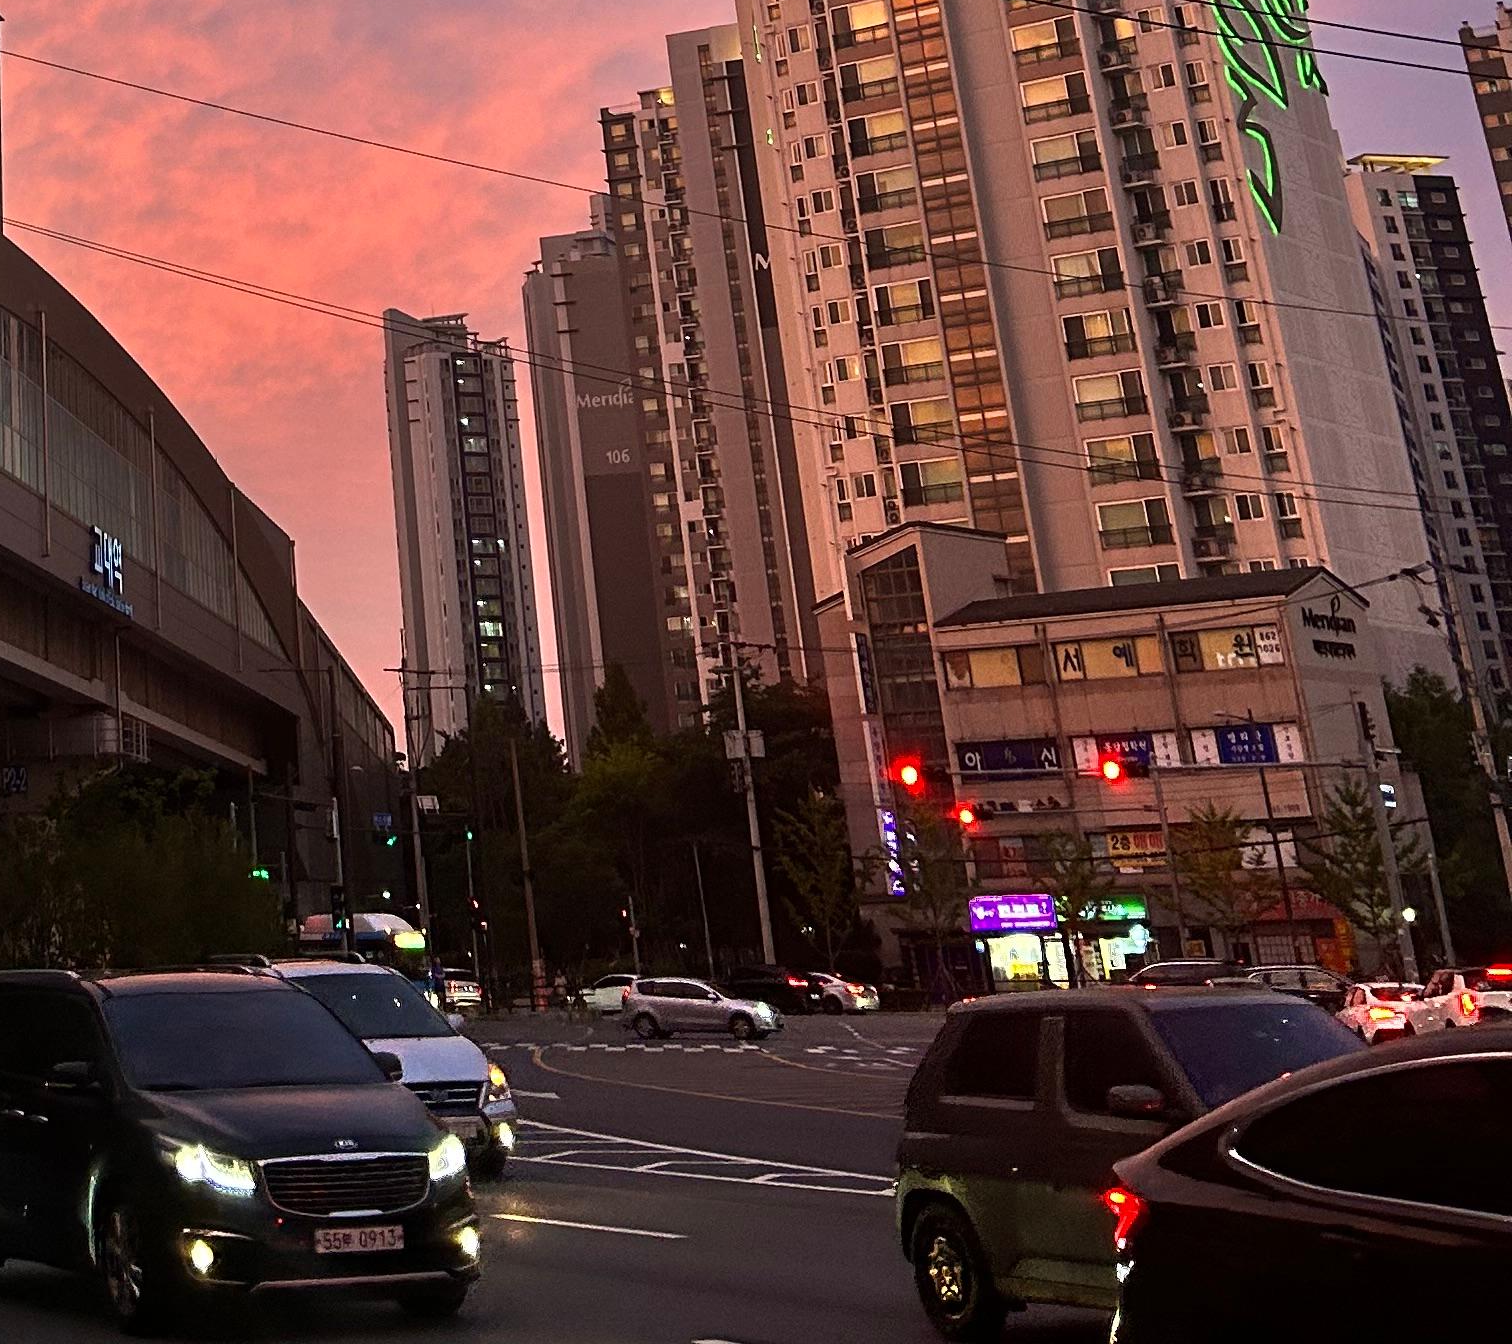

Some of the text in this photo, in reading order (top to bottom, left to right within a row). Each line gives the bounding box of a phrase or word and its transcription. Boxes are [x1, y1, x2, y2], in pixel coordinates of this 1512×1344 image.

[606, 448, 630, 464] 106
[94, 524, 124, 596] 교대역
[359, 1227, 397, 1248] 0913
